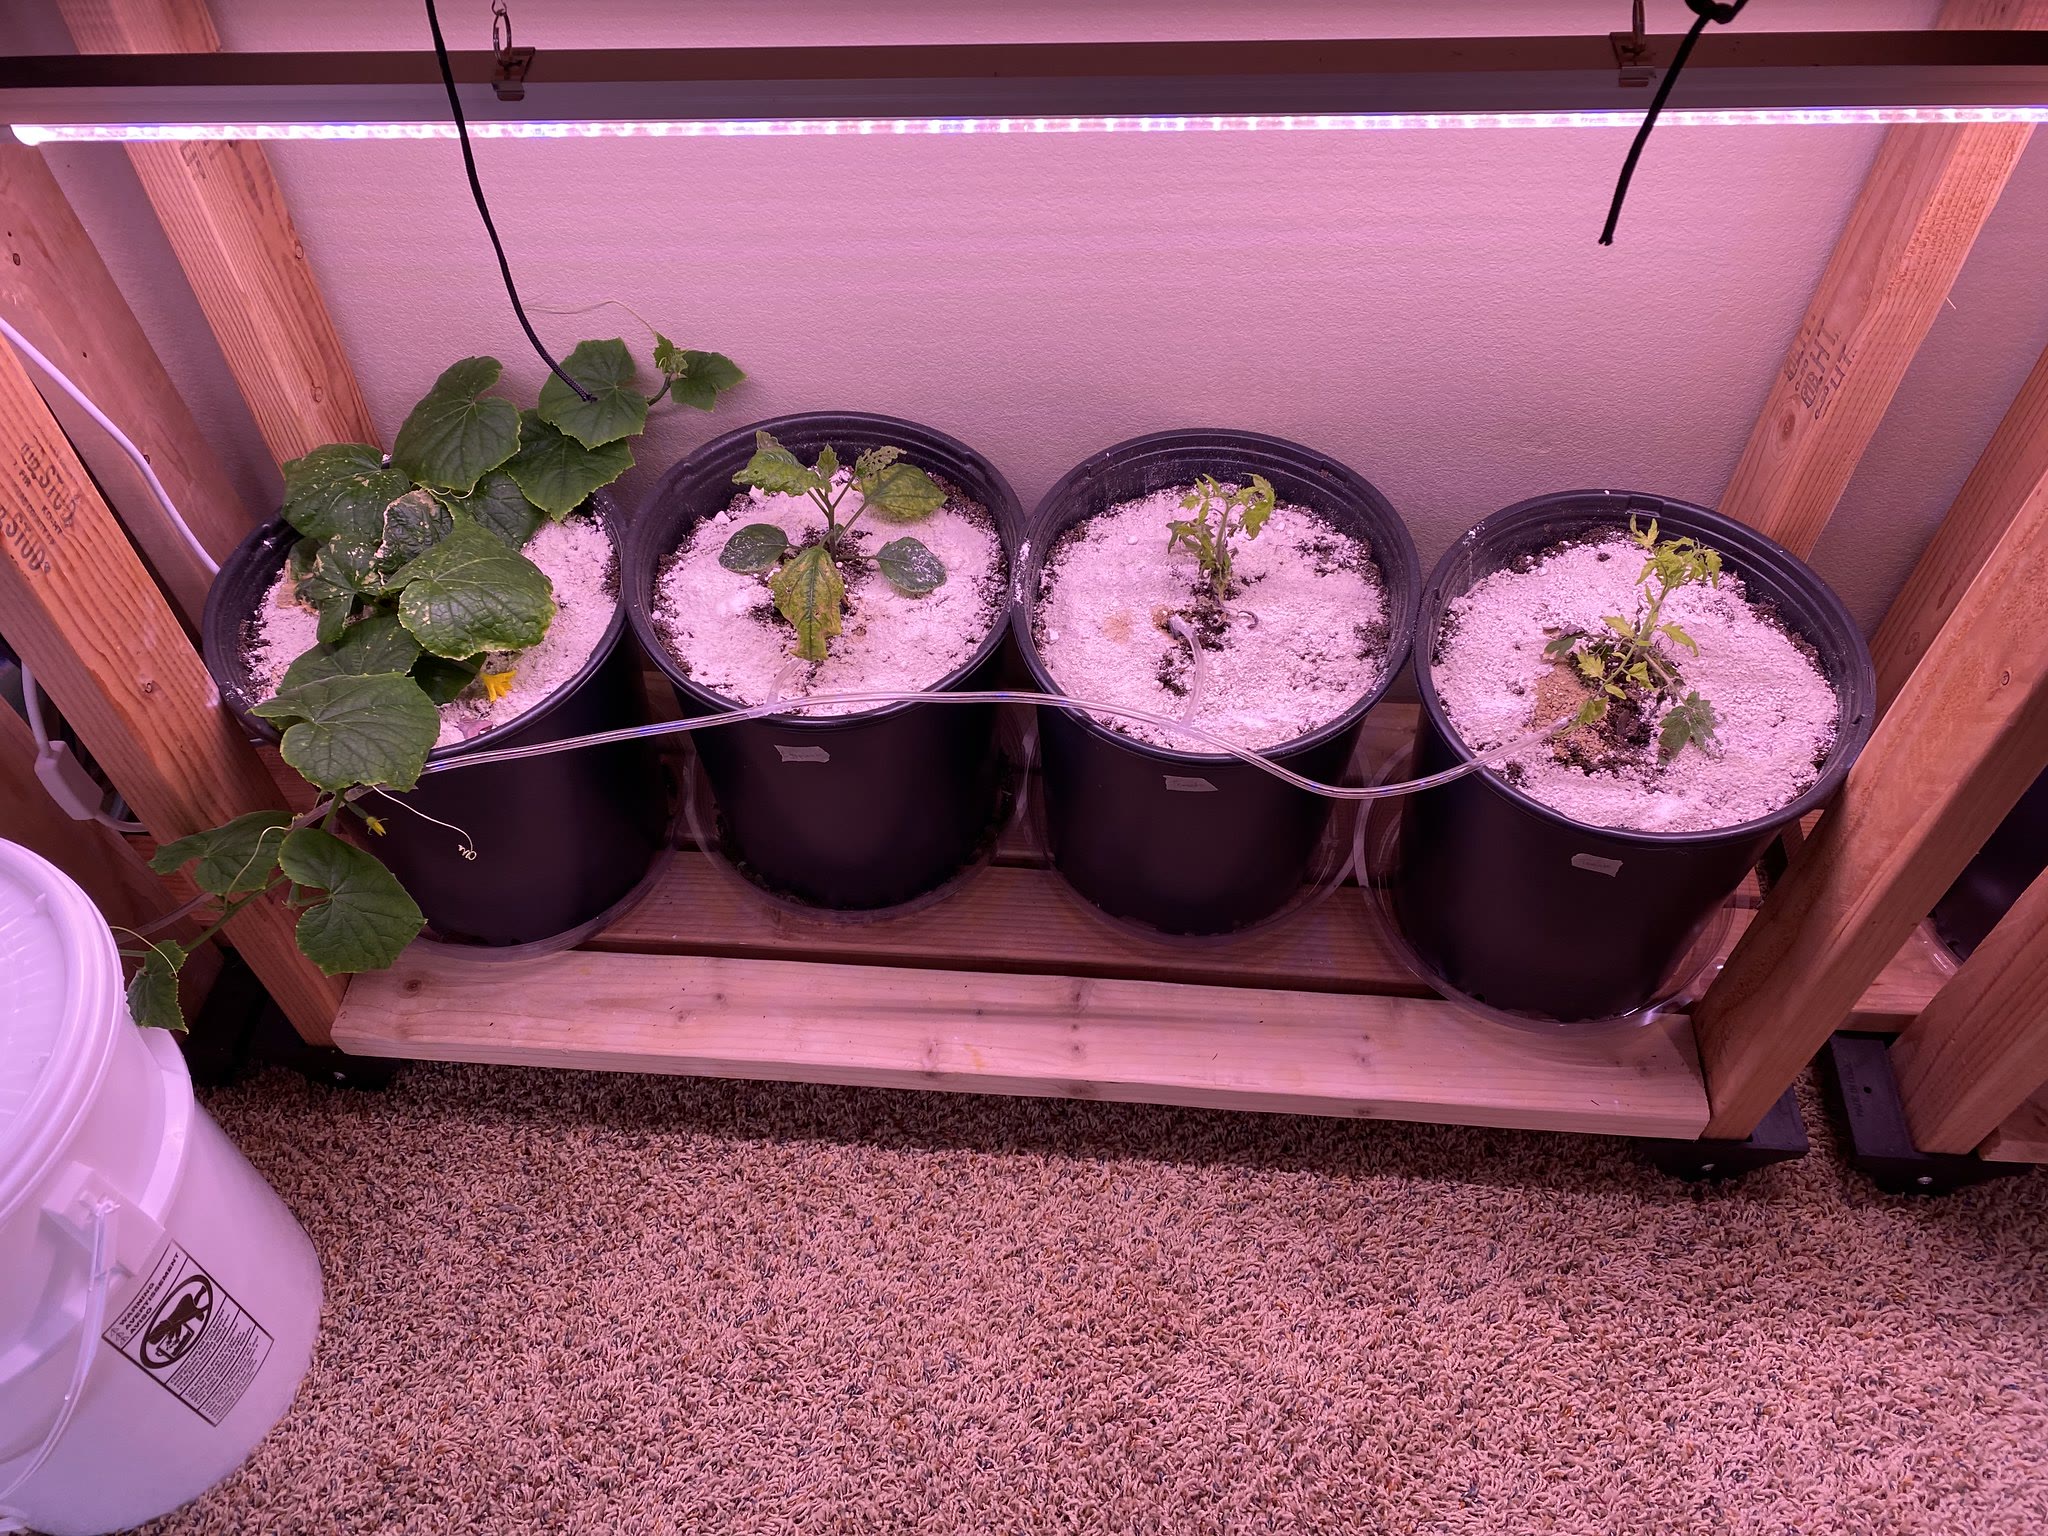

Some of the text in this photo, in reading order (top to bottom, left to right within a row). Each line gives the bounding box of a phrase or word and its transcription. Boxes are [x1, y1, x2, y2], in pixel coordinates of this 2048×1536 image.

[6, 512, 46, 571] STUD
[119, 1281, 155, 1327] WARNING
[124, 1252, 180, 1331] AVERTISSEMENT
[129, 1306, 153, 1335] AVISO
